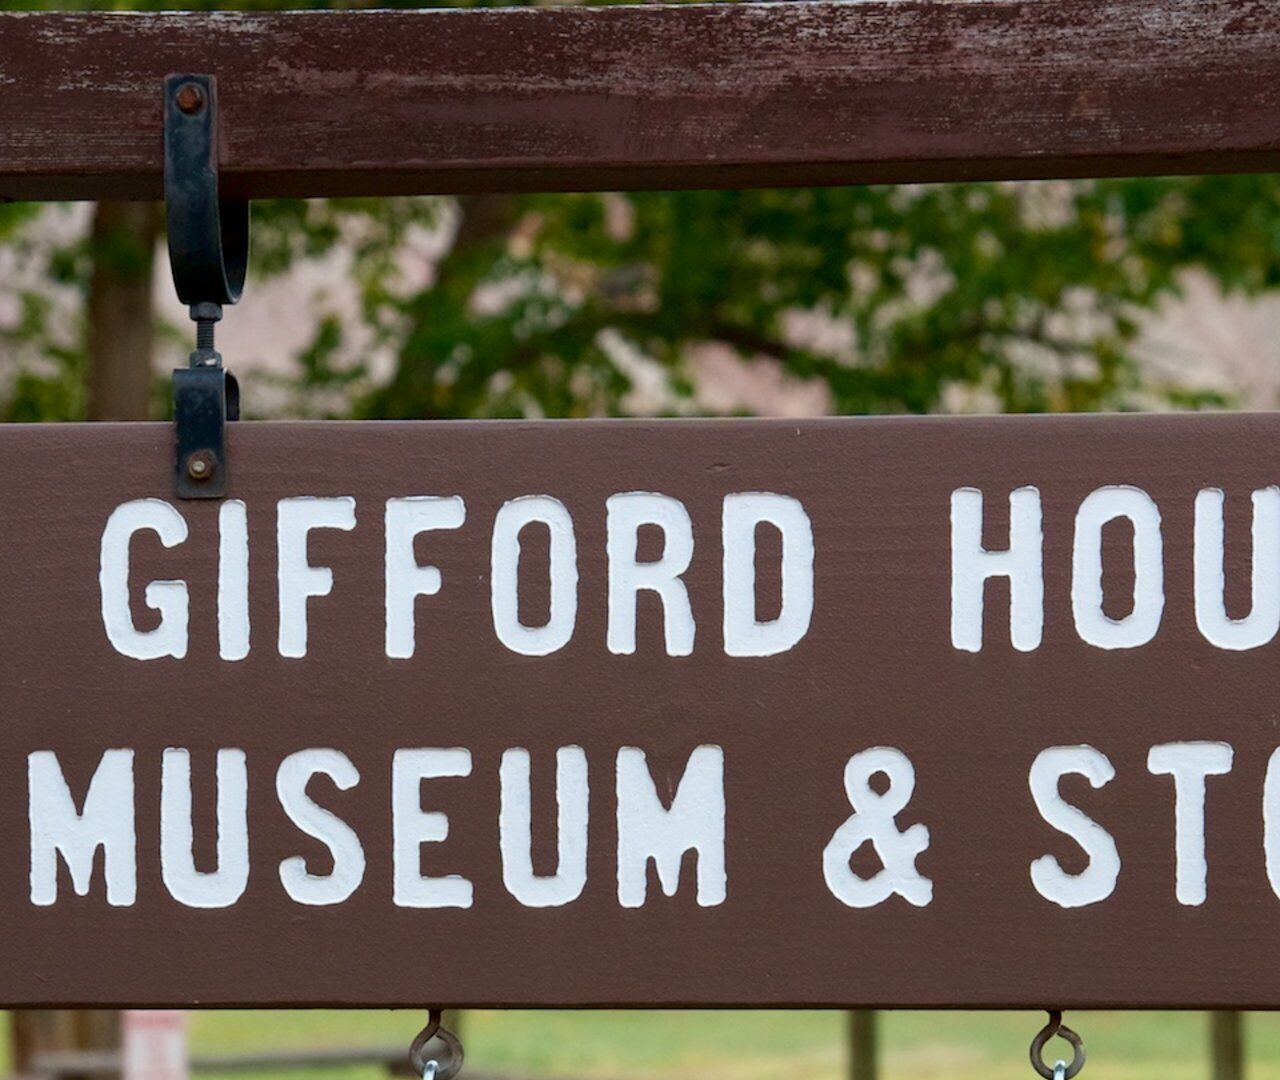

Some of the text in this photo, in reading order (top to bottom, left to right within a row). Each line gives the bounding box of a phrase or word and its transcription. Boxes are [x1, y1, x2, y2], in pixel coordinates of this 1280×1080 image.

[97, 490, 816, 663] GIFFORD
[26, 744, 729, 910] MUSEUM
[821, 745, 934, 910] &
